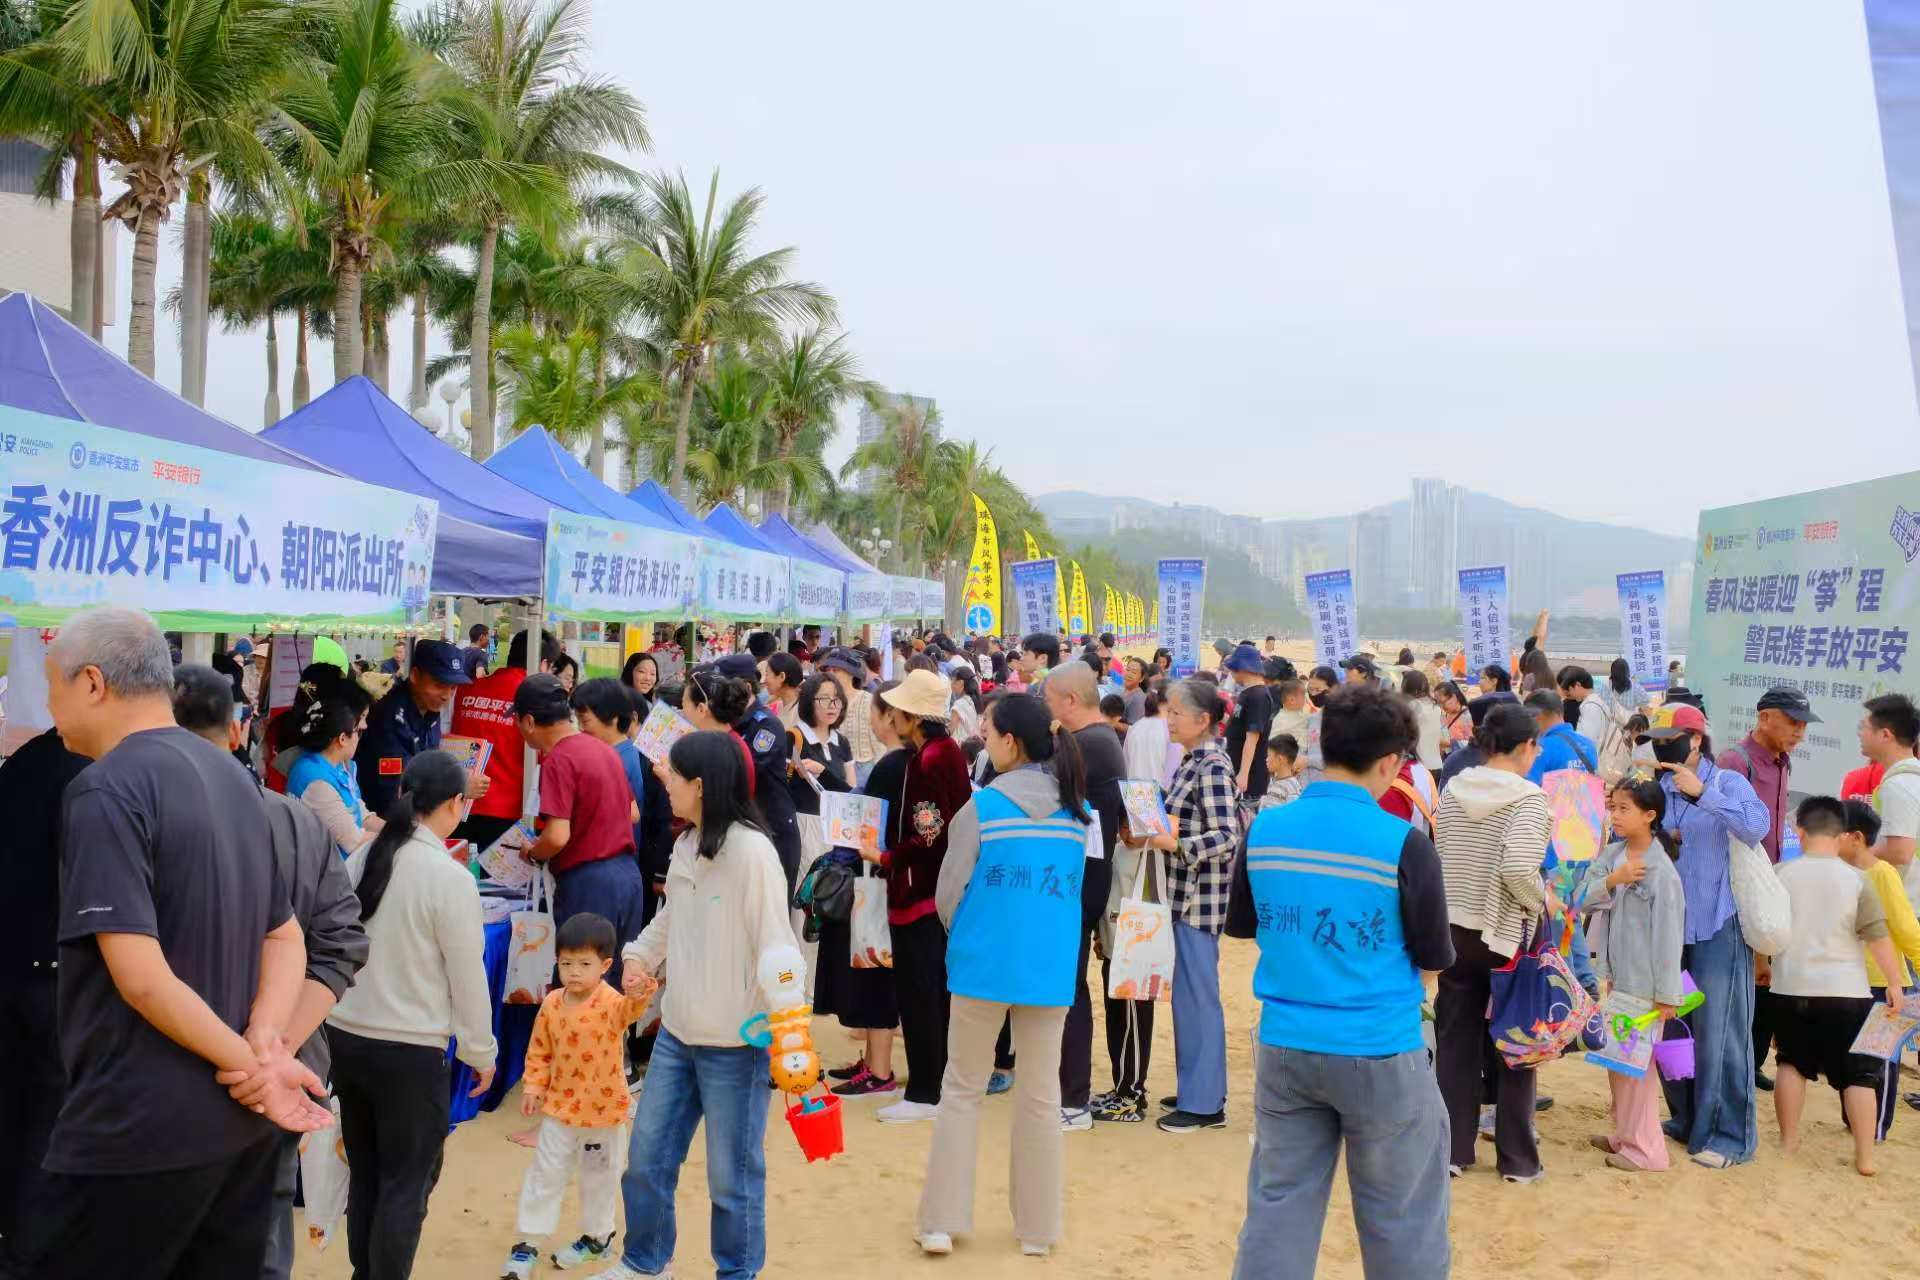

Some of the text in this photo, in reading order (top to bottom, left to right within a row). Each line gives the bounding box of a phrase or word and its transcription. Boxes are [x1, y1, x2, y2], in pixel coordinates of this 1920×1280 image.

[0, 431, 17, 453] 安
[152, 458, 201, 485] 平安银行
[571, 551, 681, 599] 平安银行珠海分行
[1468, 583, 1485, 665] 陌生来电不听信
[1487, 588, 1502, 664] 个人信息不透
[1743, 623, 1909, 674] 警民携手放平安
[984, 863, 1031, 889] 香洲
